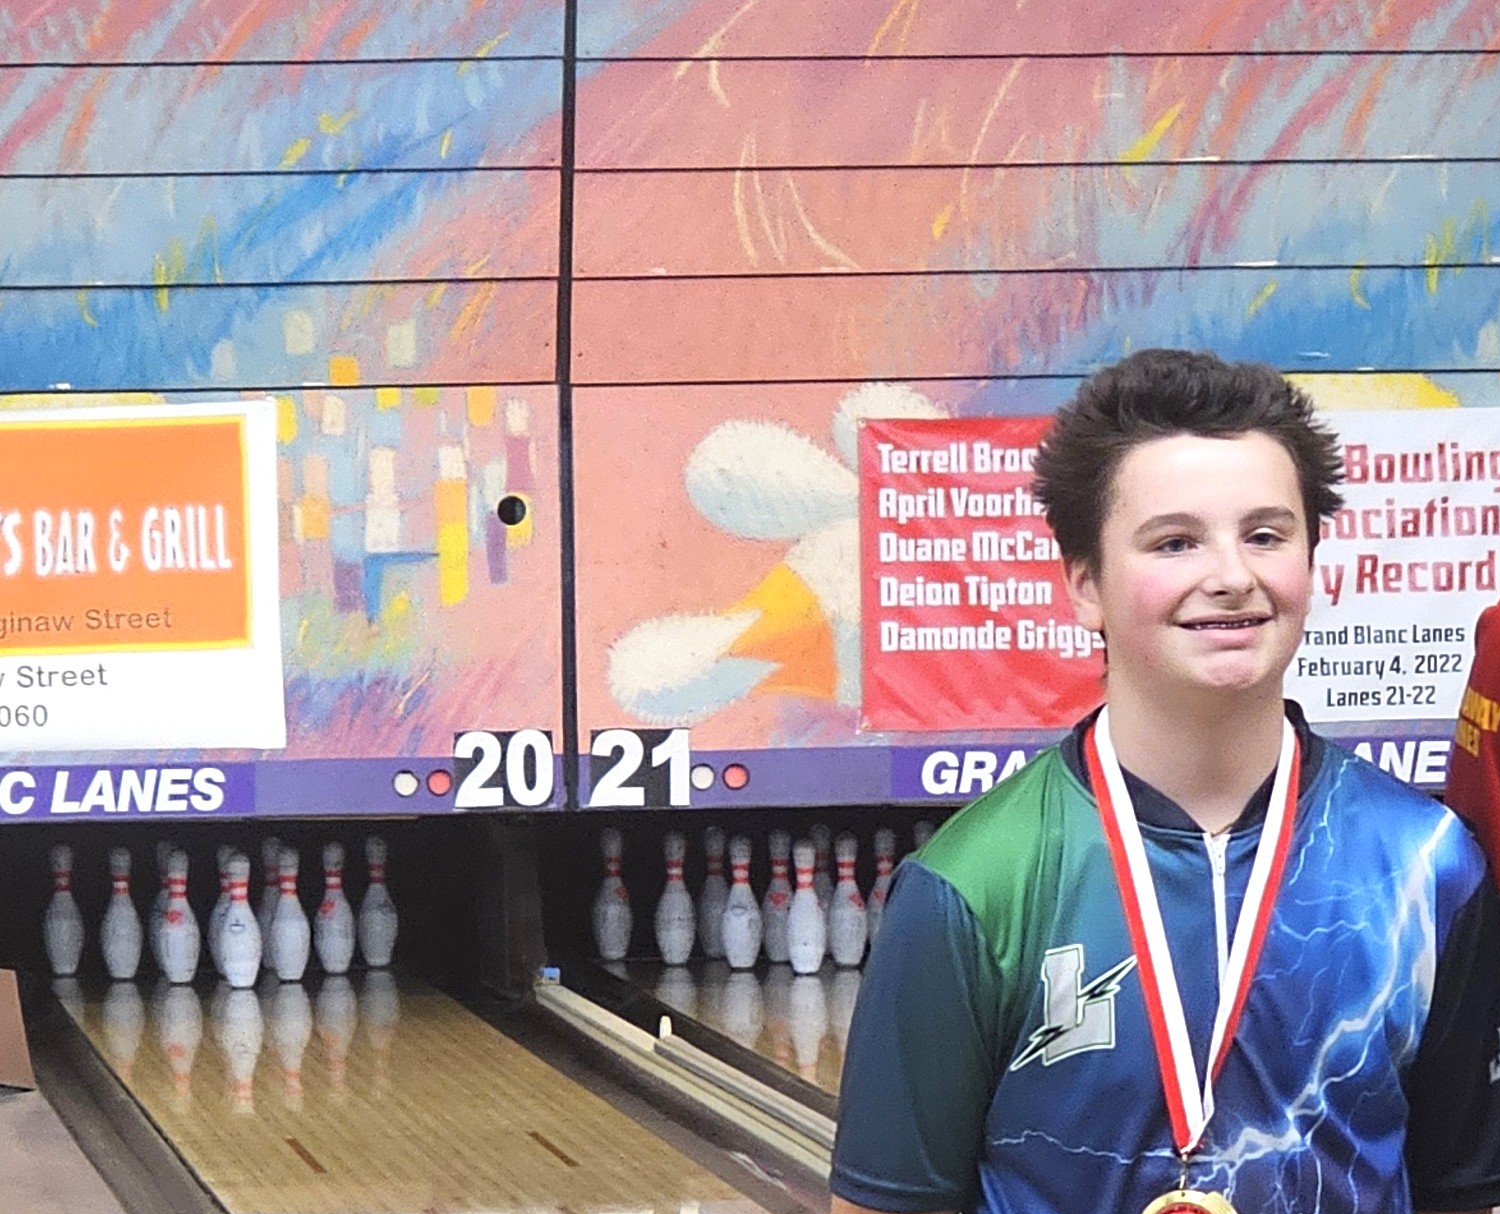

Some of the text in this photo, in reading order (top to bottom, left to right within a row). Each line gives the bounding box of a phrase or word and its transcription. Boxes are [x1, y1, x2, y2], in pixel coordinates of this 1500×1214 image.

[877, 441, 1047, 473] Terrell Broo
[879, 487, 945, 524] April
[1321, 496, 1500, 541] ociation
[33, 508, 97, 577] BAR
[108, 508, 131, 572] &
[141, 504, 233, 572] GRILL
[879, 532, 966, 562] Duane
[1355, 550, 1496, 594] Record
[880, 575, 1052, 612] Deion Tipton
[85, 607, 172, 630] Street
[1305, 624, 1465, 645] rand Blanc Lanes
[881, 619, 1105, 658] Damonde Griggs
[16, 664, 108, 688] Street
[1297, 657, 1385, 680] February
[1414, 654, 1463, 674] 2022
[1327, 685, 1436, 707] Lanes 21-22
[454, 729, 553, 808] 20
[589, 728, 690, 807] 21
[921, 750, 1040, 795] GRA
[50, 767, 226, 813] LANES
